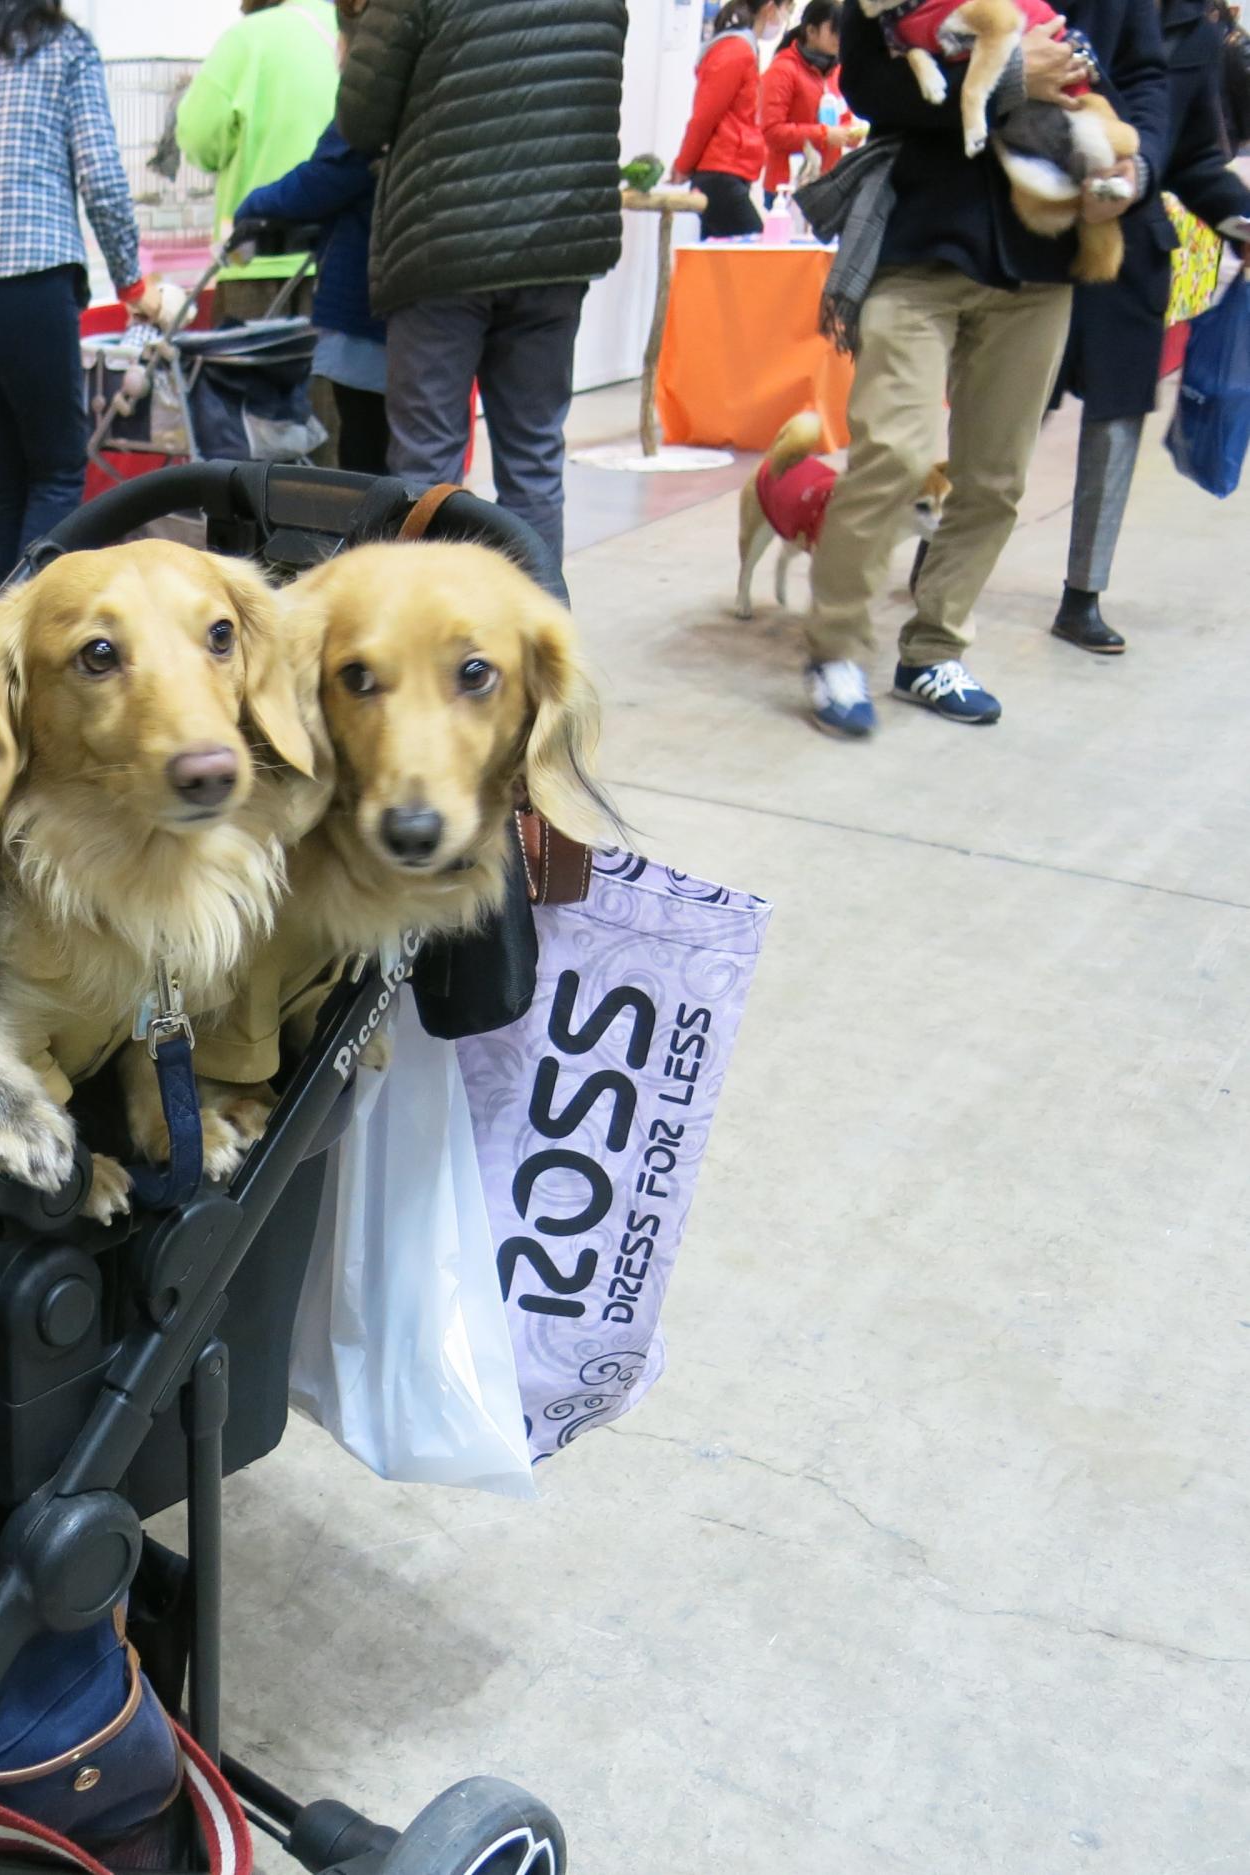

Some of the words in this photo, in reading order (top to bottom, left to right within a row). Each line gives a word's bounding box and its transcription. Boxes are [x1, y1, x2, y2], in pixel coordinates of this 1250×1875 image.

[333, 961, 406, 1081] Piccolo
[658, 1002, 712, 1106] LESS
[496, 969, 656, 1319] ROSS
[636, 1118, 685, 1199] FOR
[602, 1210, 661, 1324] DRESS
